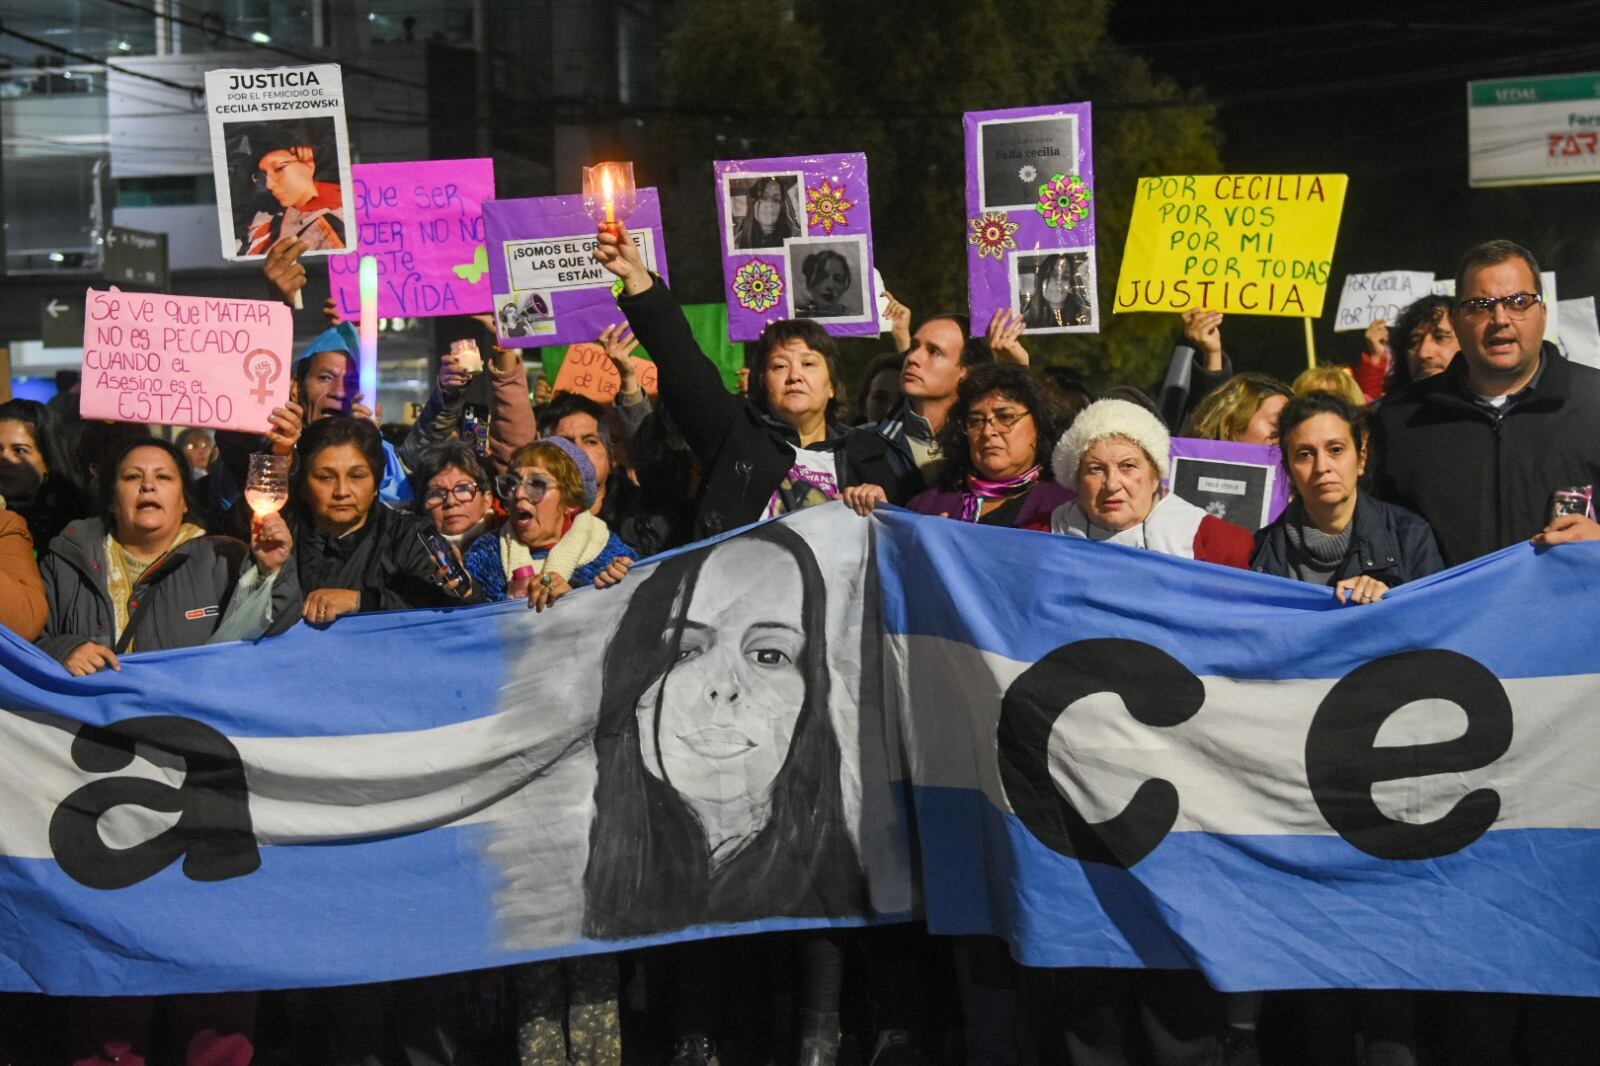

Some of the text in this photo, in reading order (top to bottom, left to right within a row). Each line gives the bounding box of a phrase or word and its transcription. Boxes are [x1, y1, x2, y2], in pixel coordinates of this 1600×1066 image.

[229, 71, 320, 90] JUSTICIA
[228, 88, 324, 101] POR EL FEMICIDIO DE
[215, 99, 339, 114] CECILIA STRZYZOWSKI
[1025, 146, 1061, 158] cecilia
[1142, 175, 1325, 202] POR CECILIA
[1159, 202, 1275, 228] POR VOS
[419, 218, 449, 244] NO
[1170, 230, 1274, 253] POR MI
[513, 244, 561, 261] ¡SOMOS
[564, 243, 580, 254] EL
[532, 259, 556, 271] LAS
[558, 256, 585, 269] QUE
[558, 268, 603, 283] ESTÁN!
[1184, 256, 1330, 285] POR TODAS
[1118, 280, 1305, 313] JUSTICIA
[91, 294, 120, 320] Se
[204, 300, 271, 325] MATAR
[97, 326, 250, 354] NO es PECADO
[86, 350, 161, 372] CUANDO
[96, 372, 163, 392] Asesino
[170, 379, 186, 395] es
[118, 391, 233, 423] ESTADO
[49, 715, 261, 889] a
